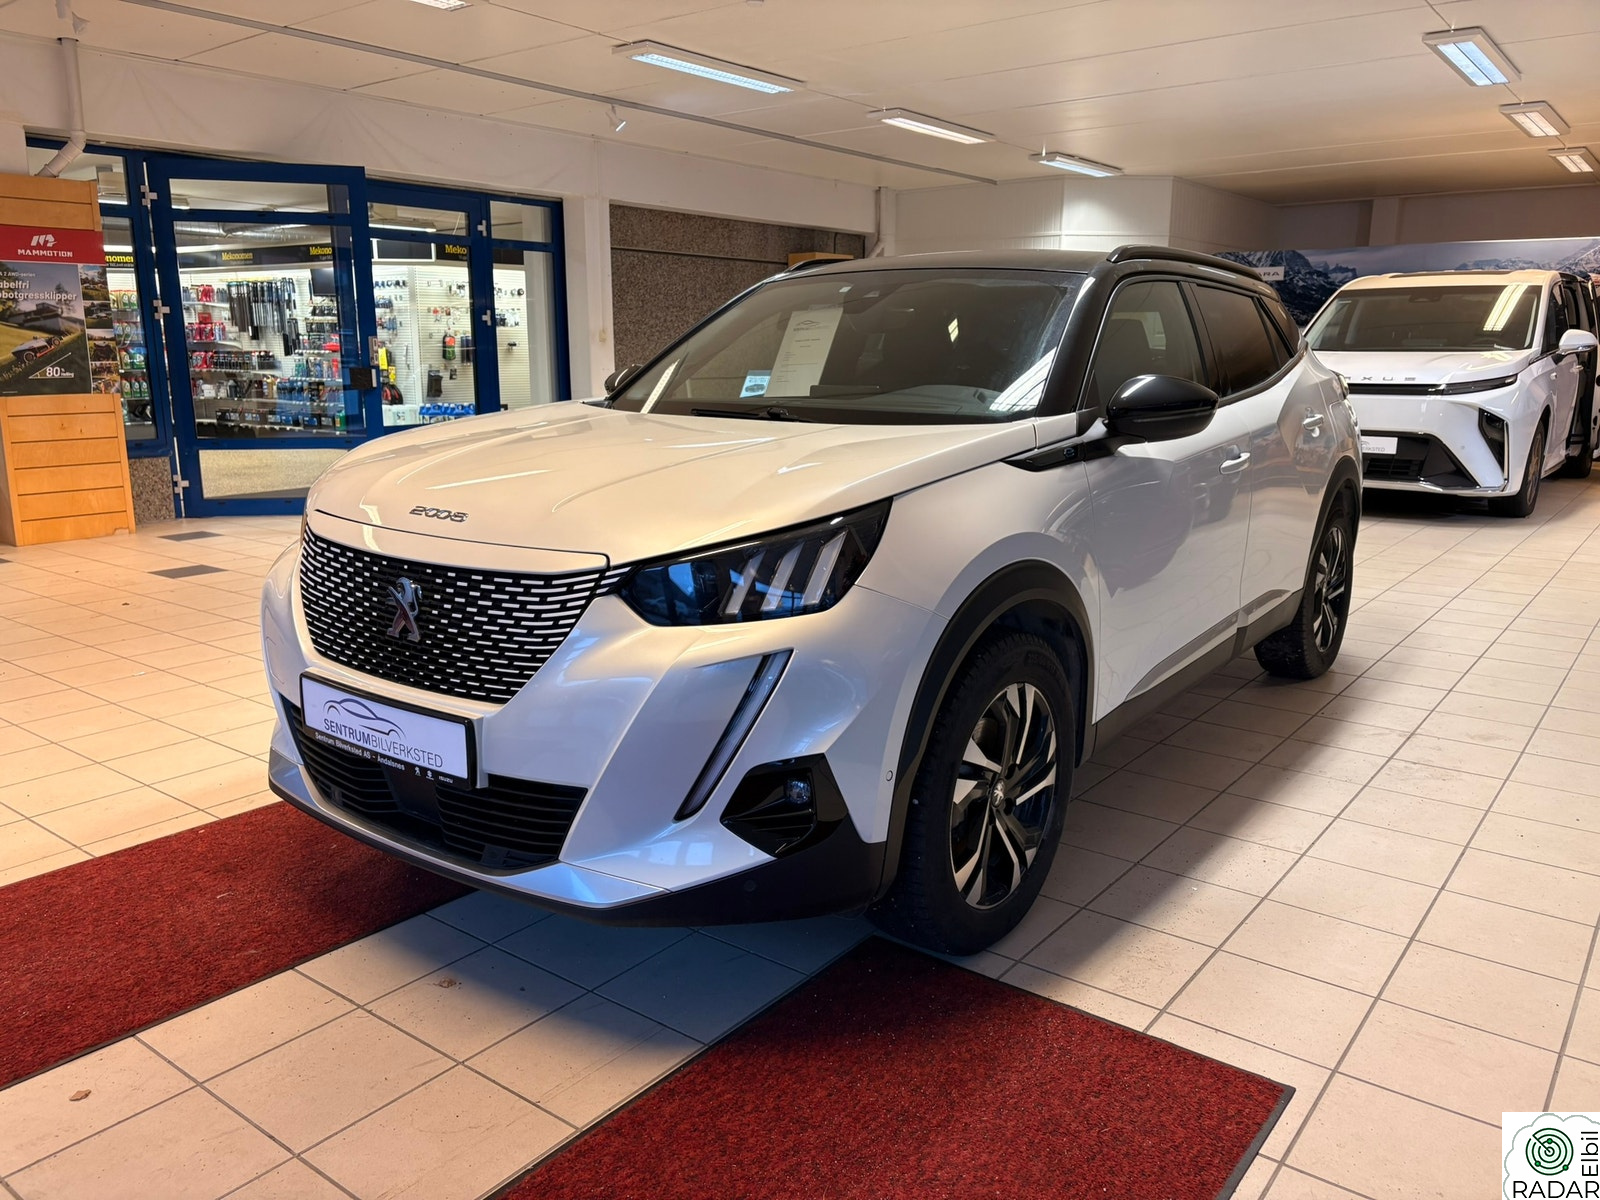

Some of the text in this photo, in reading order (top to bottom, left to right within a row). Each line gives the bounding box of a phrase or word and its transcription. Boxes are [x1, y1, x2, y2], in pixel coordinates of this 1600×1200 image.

[17, 248, 73, 258] MAMMOTION
[445, 244, 467, 255] Meko
[222, 252, 253, 261] Mekonomen
[0, 291, 77, 302] botgressklipper
[46, 366, 61, 377] 80
[408, 505, 469, 523] 2008
[315, 732, 335, 745] Sentrum
[335, 740, 363, 756] Bilverksted
[363, 750, 371, 759] AS
[323, 718, 443, 768] SENTRUMBILVERKSTED
